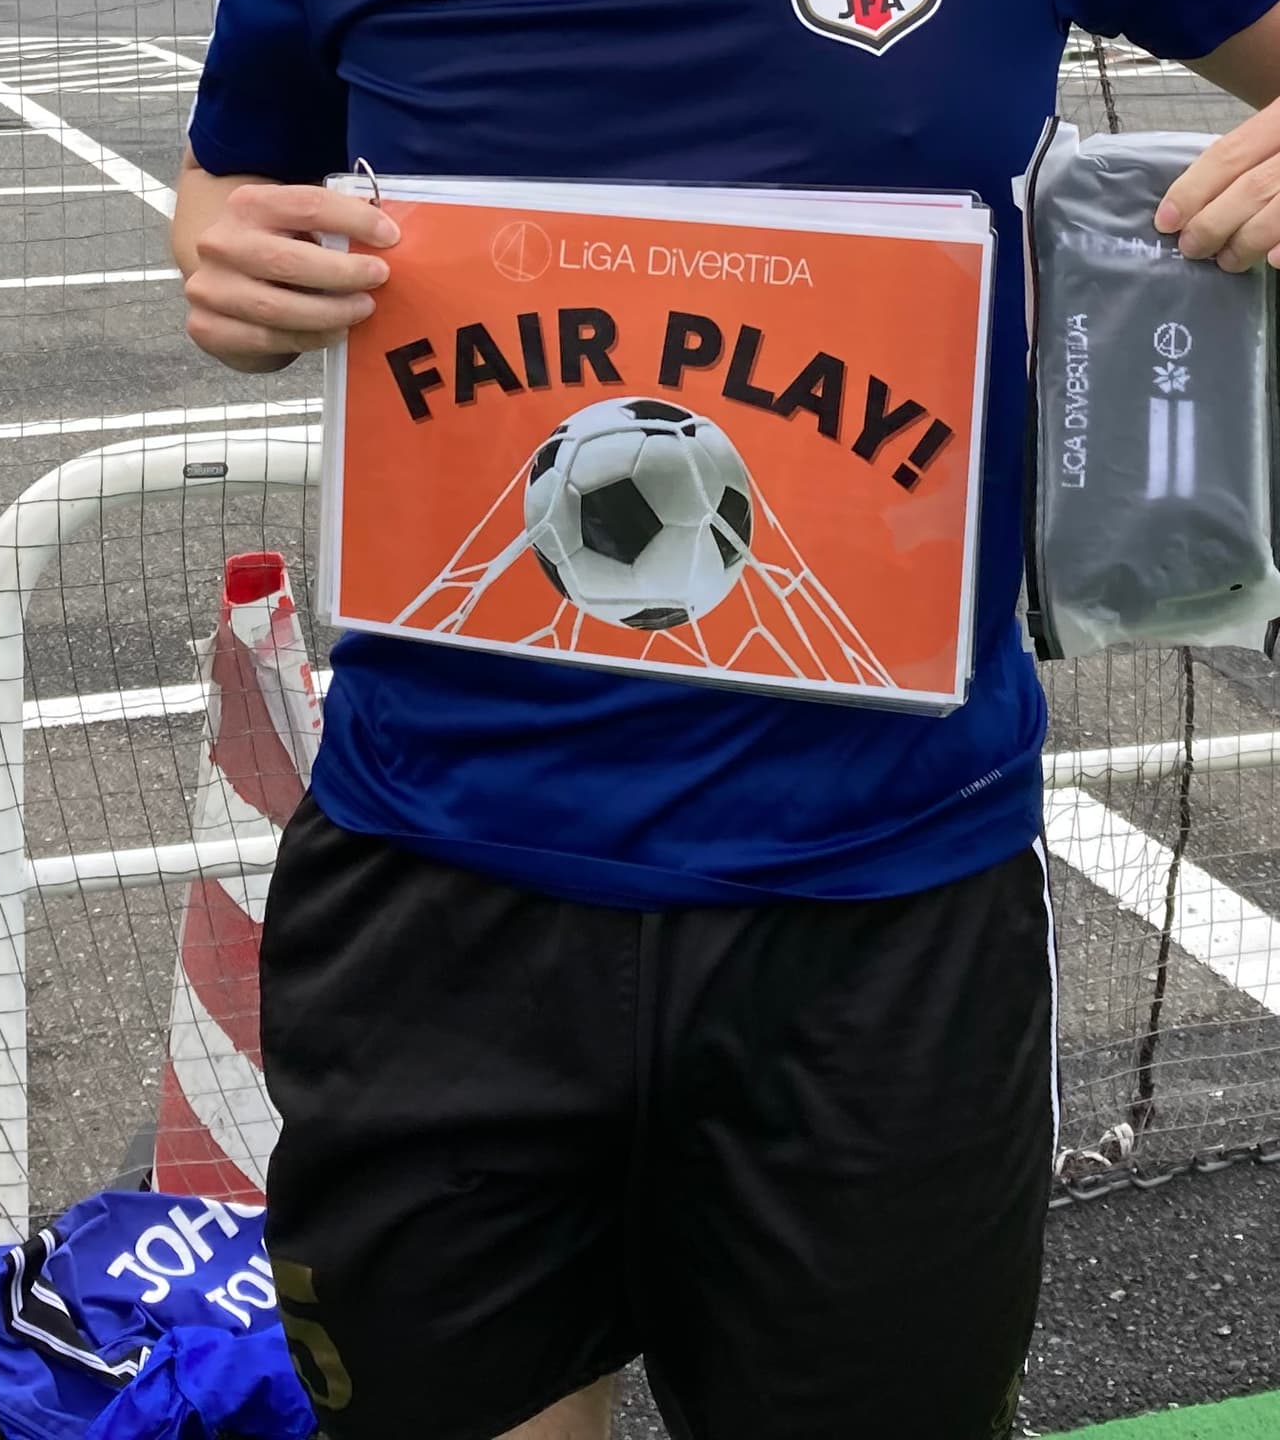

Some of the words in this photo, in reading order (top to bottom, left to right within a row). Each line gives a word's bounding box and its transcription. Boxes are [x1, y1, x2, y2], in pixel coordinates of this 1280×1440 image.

[384, 306, 623, 423] FAIR
[657, 310, 953, 493] PLAY!
[106, 1197, 267, 1304] JOH
